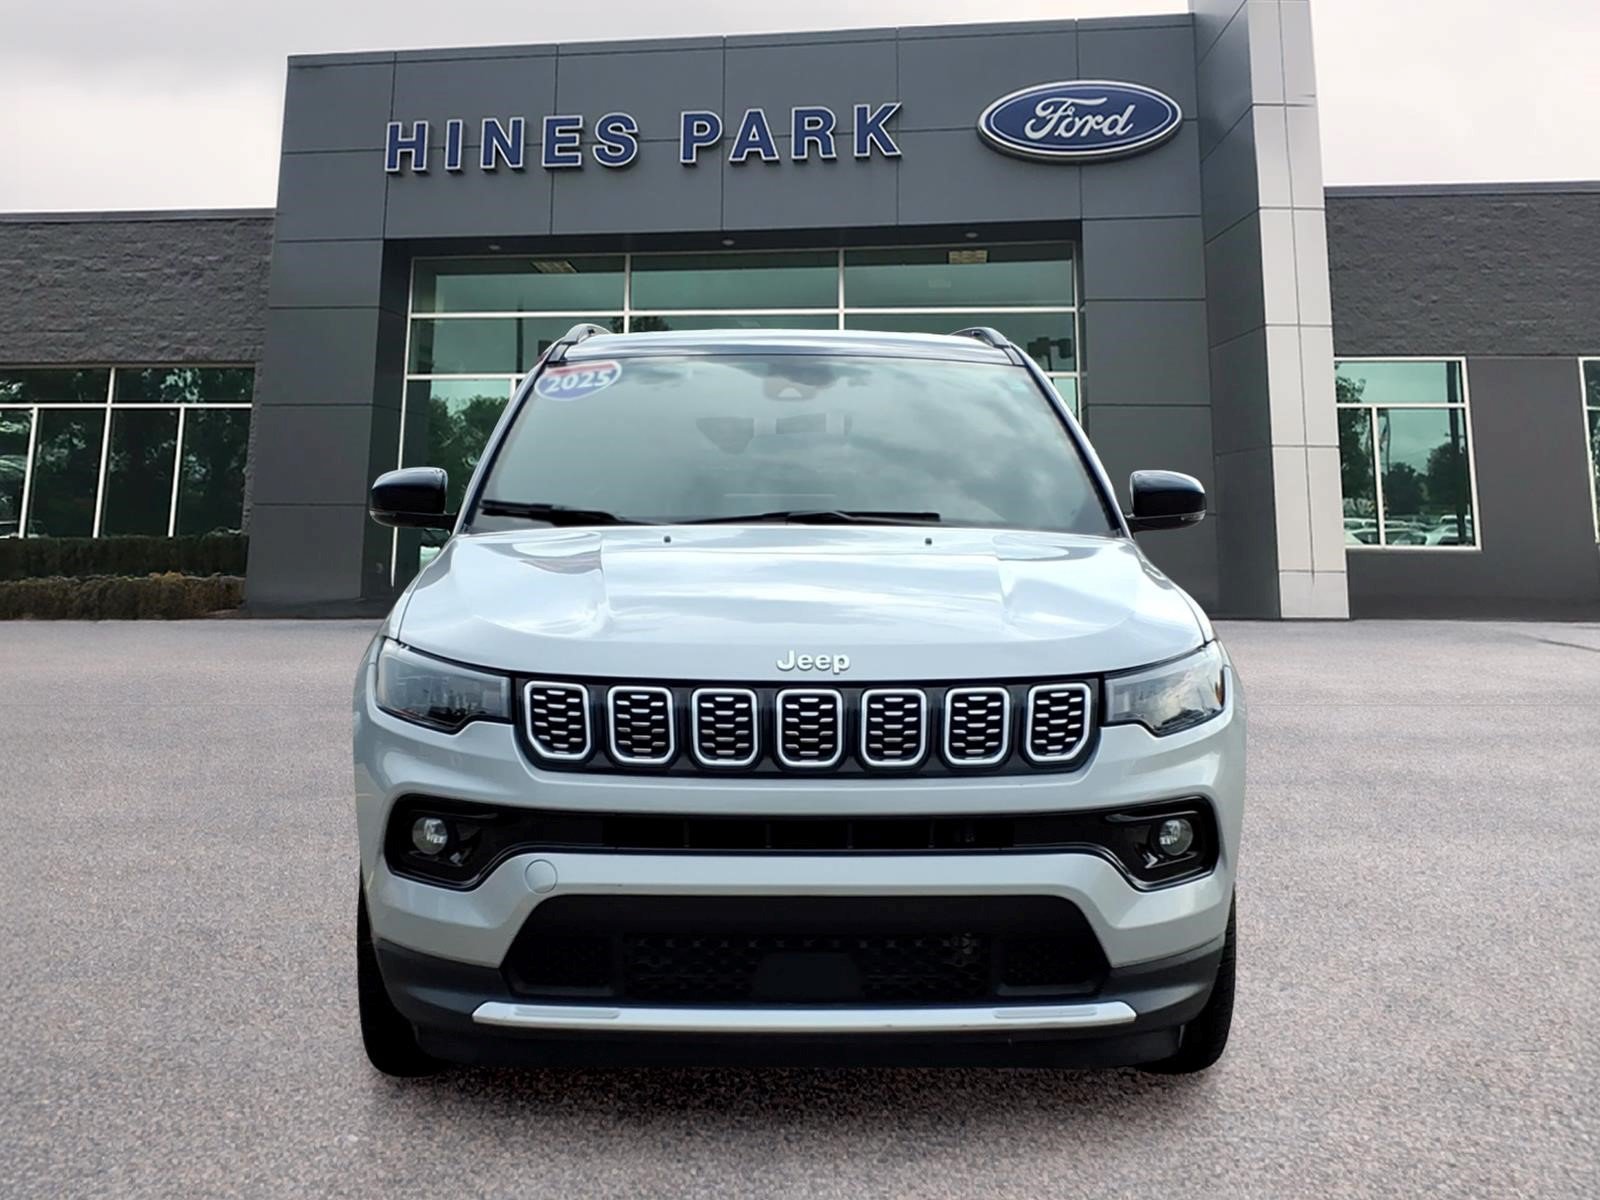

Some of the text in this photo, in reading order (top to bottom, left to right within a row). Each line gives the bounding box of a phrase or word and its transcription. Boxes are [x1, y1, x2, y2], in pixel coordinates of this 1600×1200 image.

[1024, 97, 1136, 139] Ford
[385, 102, 902, 173] HINES PARK
[544, 370, 611, 394] 2025
[776, 650, 850, 675] Jeep
